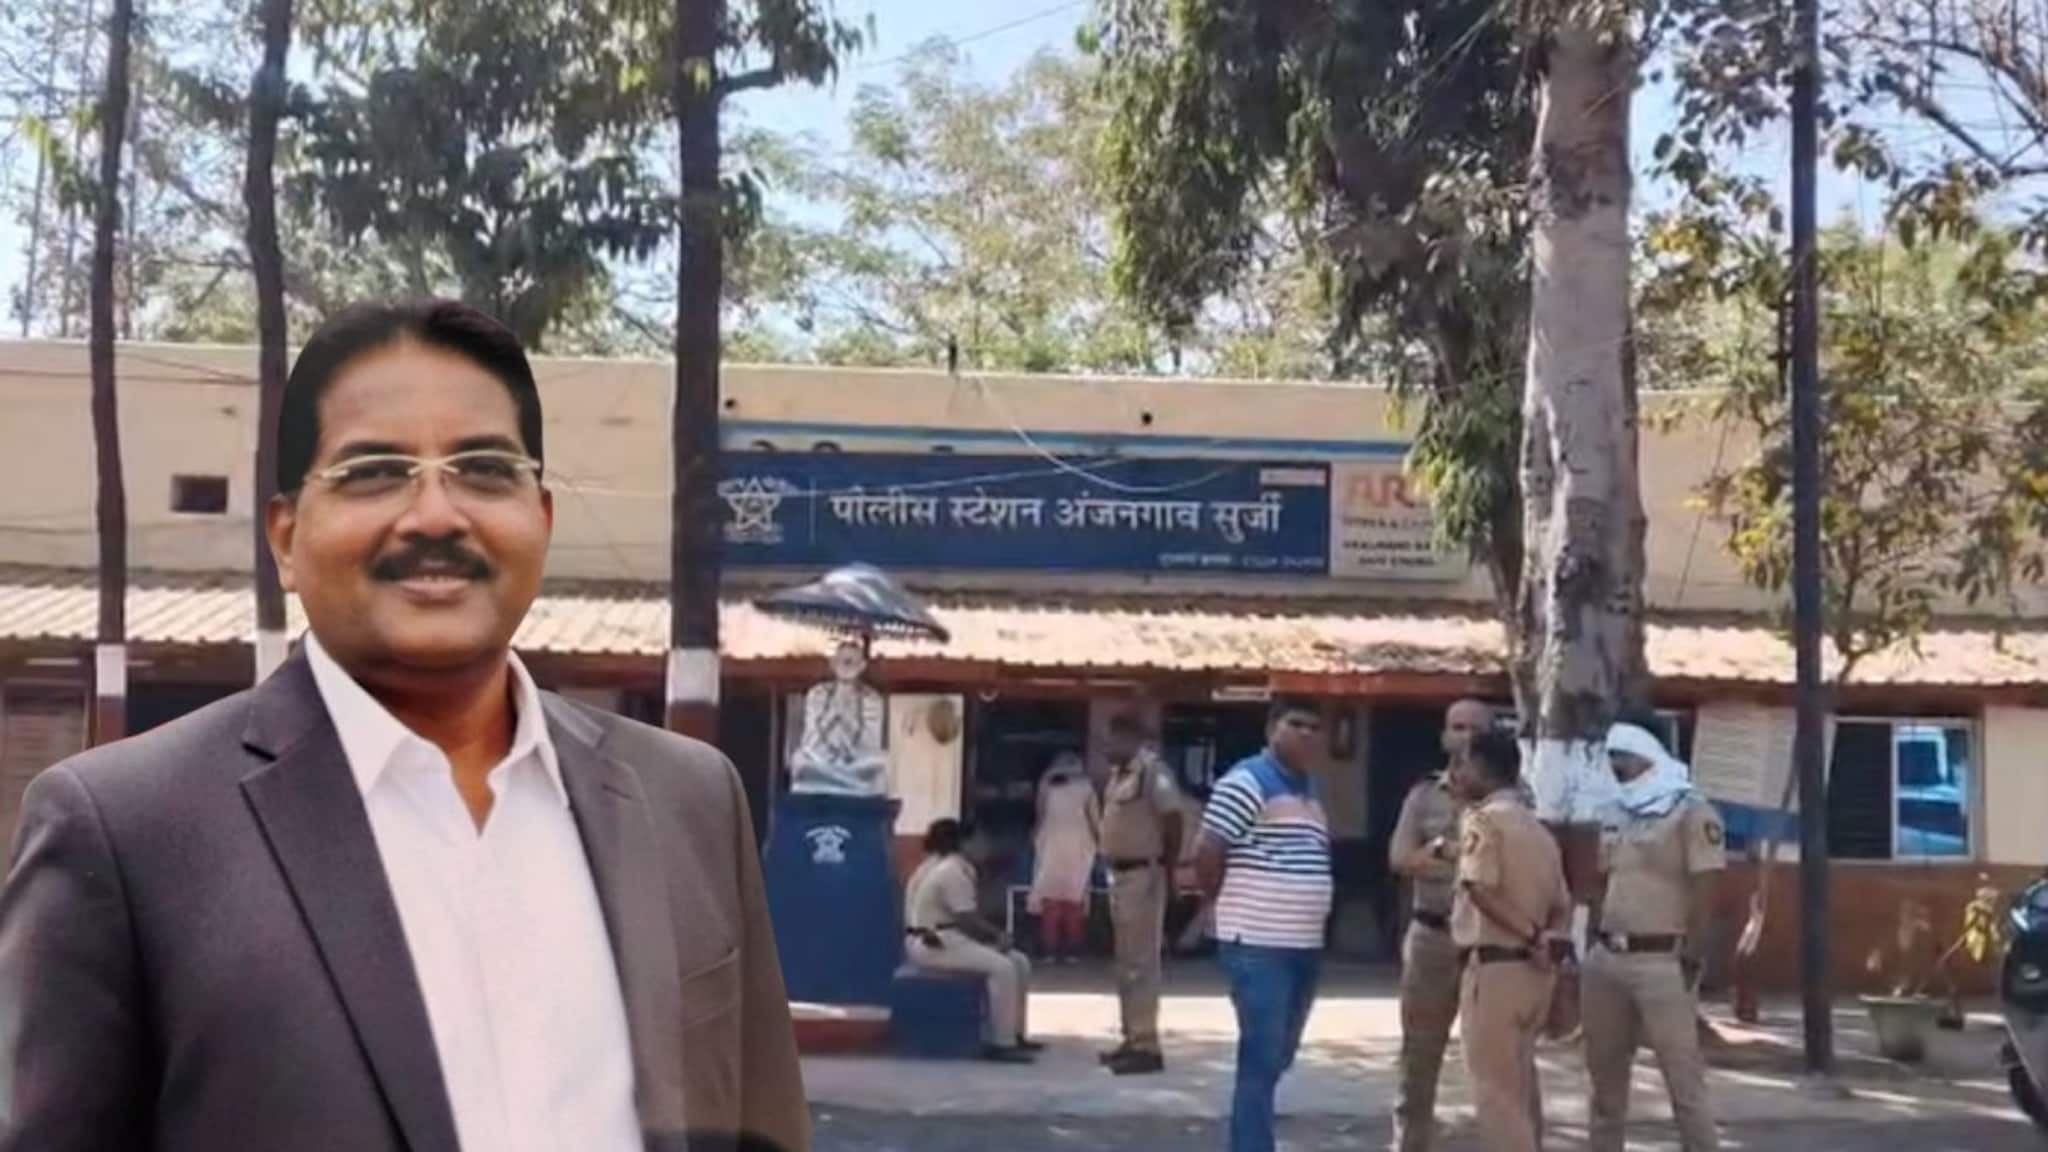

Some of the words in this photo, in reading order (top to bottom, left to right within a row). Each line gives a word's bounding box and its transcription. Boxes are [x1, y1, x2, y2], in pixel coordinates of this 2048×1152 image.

[950, 487, 1041, 529] स्टेशन
[1055, 486, 1202, 530] अंजनगाव
[1212, 485, 1282, 550] सुर्जी
